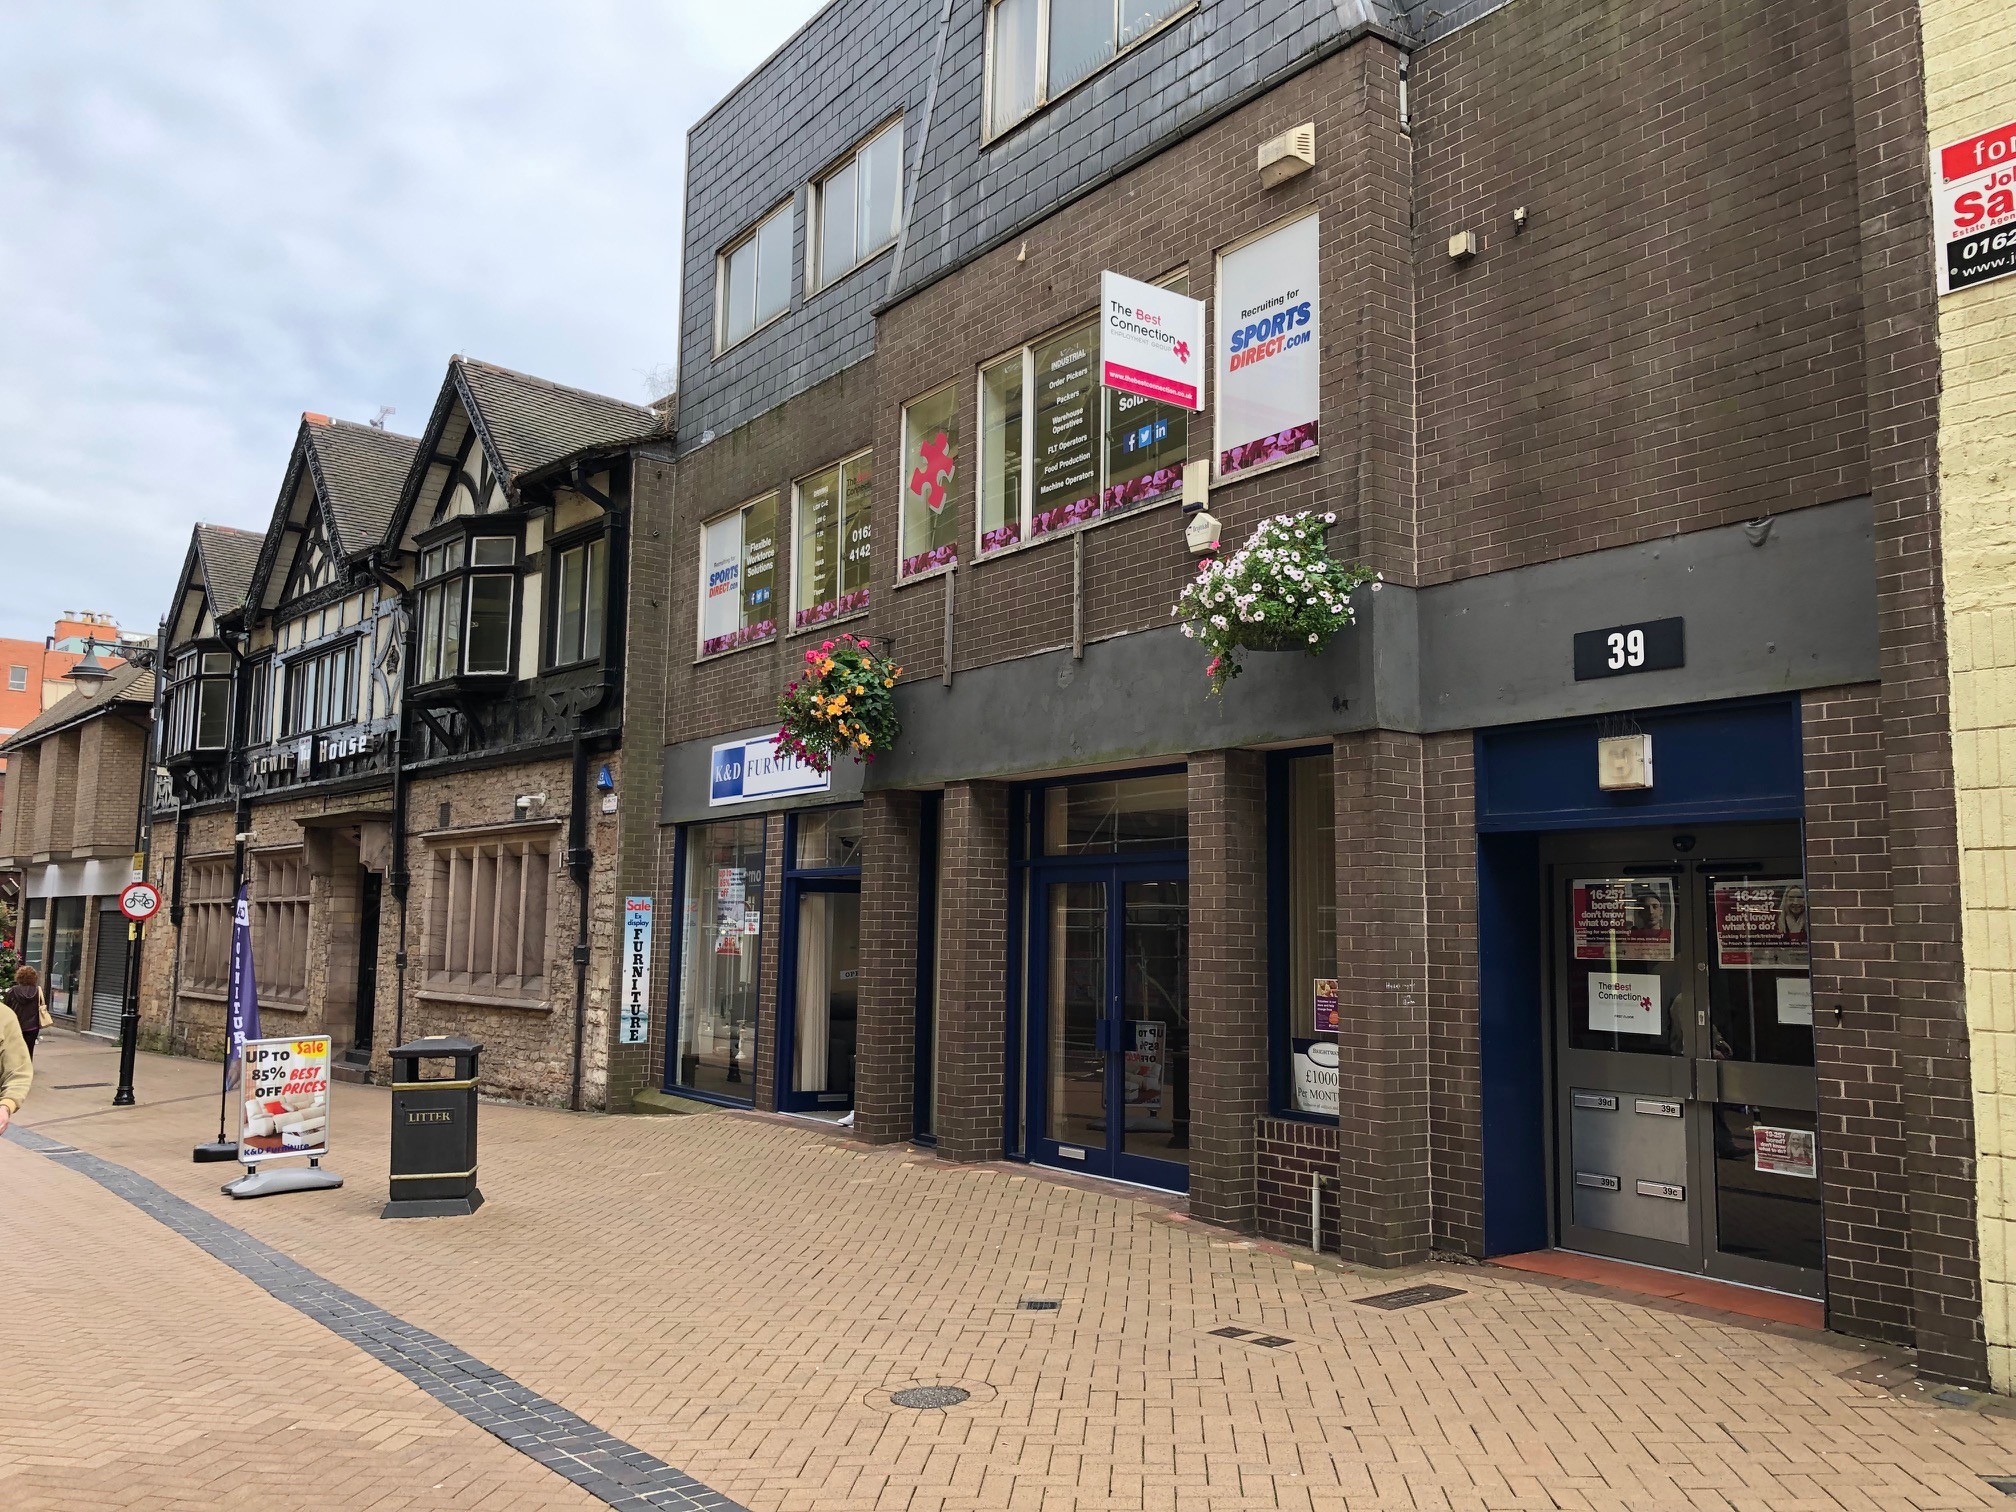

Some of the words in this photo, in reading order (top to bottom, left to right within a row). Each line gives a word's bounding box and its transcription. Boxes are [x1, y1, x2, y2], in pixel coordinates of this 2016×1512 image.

[1952, 224, 1985, 239] Estate
[1962, 253, 2016, 278] www.j
[1241, 295, 1284, 319] Recruiting
[1286, 289, 1300, 300] for
[1110, 300, 1132, 317] The
[1135, 308, 1162, 327] Best
[1110, 315, 1176, 345] Connection
[1230, 302, 1311, 353] SPORTS
[1229, 330, 1311, 372] DIRECT.COM
[1051, 350, 1087, 371] INDUSTRIAL
[1049, 376, 1065, 390] Order
[1066, 367, 1088, 381] Pickers
[1109, 370, 1193, 400] www.thebestconnection.co.uk
[1056, 389, 1080, 405] Packers
[1119, 393, 1150, 412] Solu
[1052, 407, 1084, 425] Warehouse
[1052, 417, 1083, 434] Operatives
[1047, 443, 1058, 455] FLT
[1059, 434, 1088, 451] Operators
[1044, 461, 1059, 475] Food
[1060, 452, 1091, 469] Production
[1040, 480, 1064, 495] Machine
[1065, 469, 1095, 486] Operators
[750, 537, 772, 553] Flexible
[747, 549, 775, 566] Workforce
[710, 563, 738, 587] SPORTS
[748, 561, 774, 578] Solutions
[1608, 630, 1644, 669] 39
[319, 735, 367, 763] House
[715, 763, 741, 783] K&D
[1590, 889, 1625, 900] 16-25?
[1734, 890, 1774, 901] 16-25?
[627, 900, 651, 911] Sale
[1592, 901, 1625, 910] bored?
[1736, 902, 1775, 912] bored?
[1578, 919, 1599, 927] what
[1600, 919, 1609, 927] to
[1610, 919, 1625, 927] do?
[1581, 911, 1602, 919] don't
[1725, 913, 1747, 921] don't
[1749, 913, 1775, 921] know
[1758, 922, 1775, 930] do?
[629, 929, 644, 1041] FURNITURE
[1598, 982, 1612, 990] The
[1598, 992, 1641, 1001] Connection
[297, 1042, 324, 1055] Sale
[246, 1051, 269, 1063] UP
[272, 1051, 290, 1061] TO
[252, 1066, 286, 1081] 85%
[290, 1067, 321, 1080] BEST
[1306, 1069, 1338, 1087] £1000
[255, 1087, 282, 1098] OFF
[282, 1080, 326, 1096] PRICES
[1298, 1087, 1308, 1098] Per
[1310, 1089, 1339, 1102] MONT
[1598, 1098, 1612, 1107] 39d
[1661, 1104, 1676, 1114] 39e
[409, 1112, 451, 1123] LITTER
[244, 1148, 263, 1156] K&D
[1601, 1178, 1615, 1187] 39b
[1663, 1186, 1678, 1196] 39c
